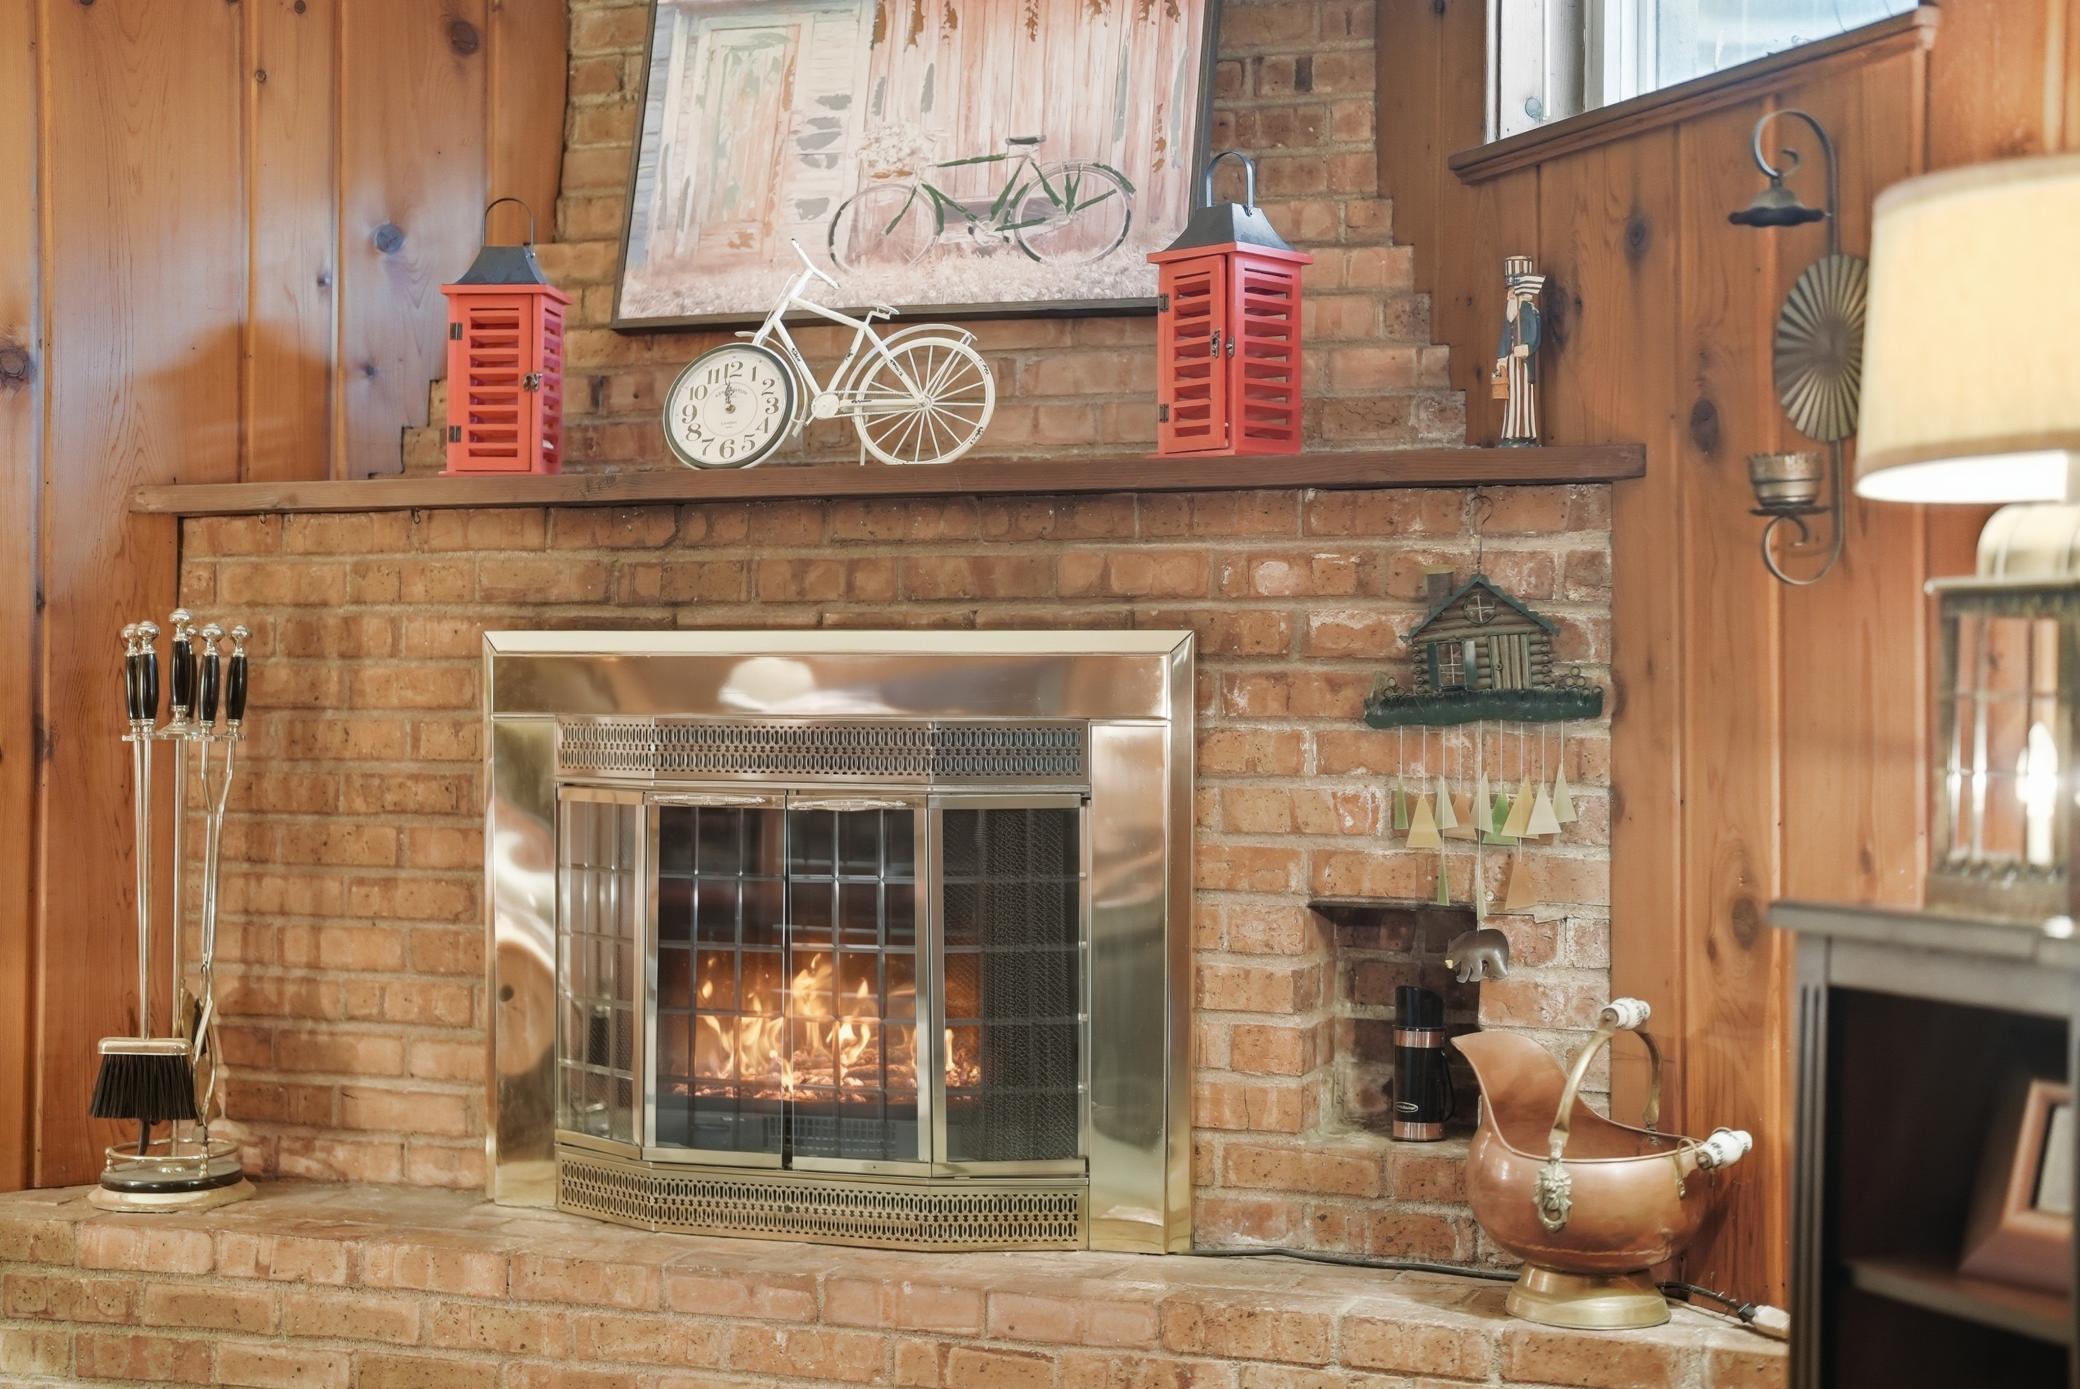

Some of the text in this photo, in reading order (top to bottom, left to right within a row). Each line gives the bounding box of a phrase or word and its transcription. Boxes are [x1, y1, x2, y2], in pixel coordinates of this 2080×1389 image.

[707, 368, 720, 385] 11
[724, 361, 744, 379] 12
[752, 366, 757, 382] 1
[689, 385, 708, 401] 10
[761, 379, 775, 396] 2
[682, 404, 698, 424] 9
[765, 397, 779, 414] 3
[686, 424, 702, 441] 8
[755, 417, 769, 434] 4
[702, 437, 715, 456] 7
[719, 439, 735, 459] 6
[741, 434, 756, 452] 5
